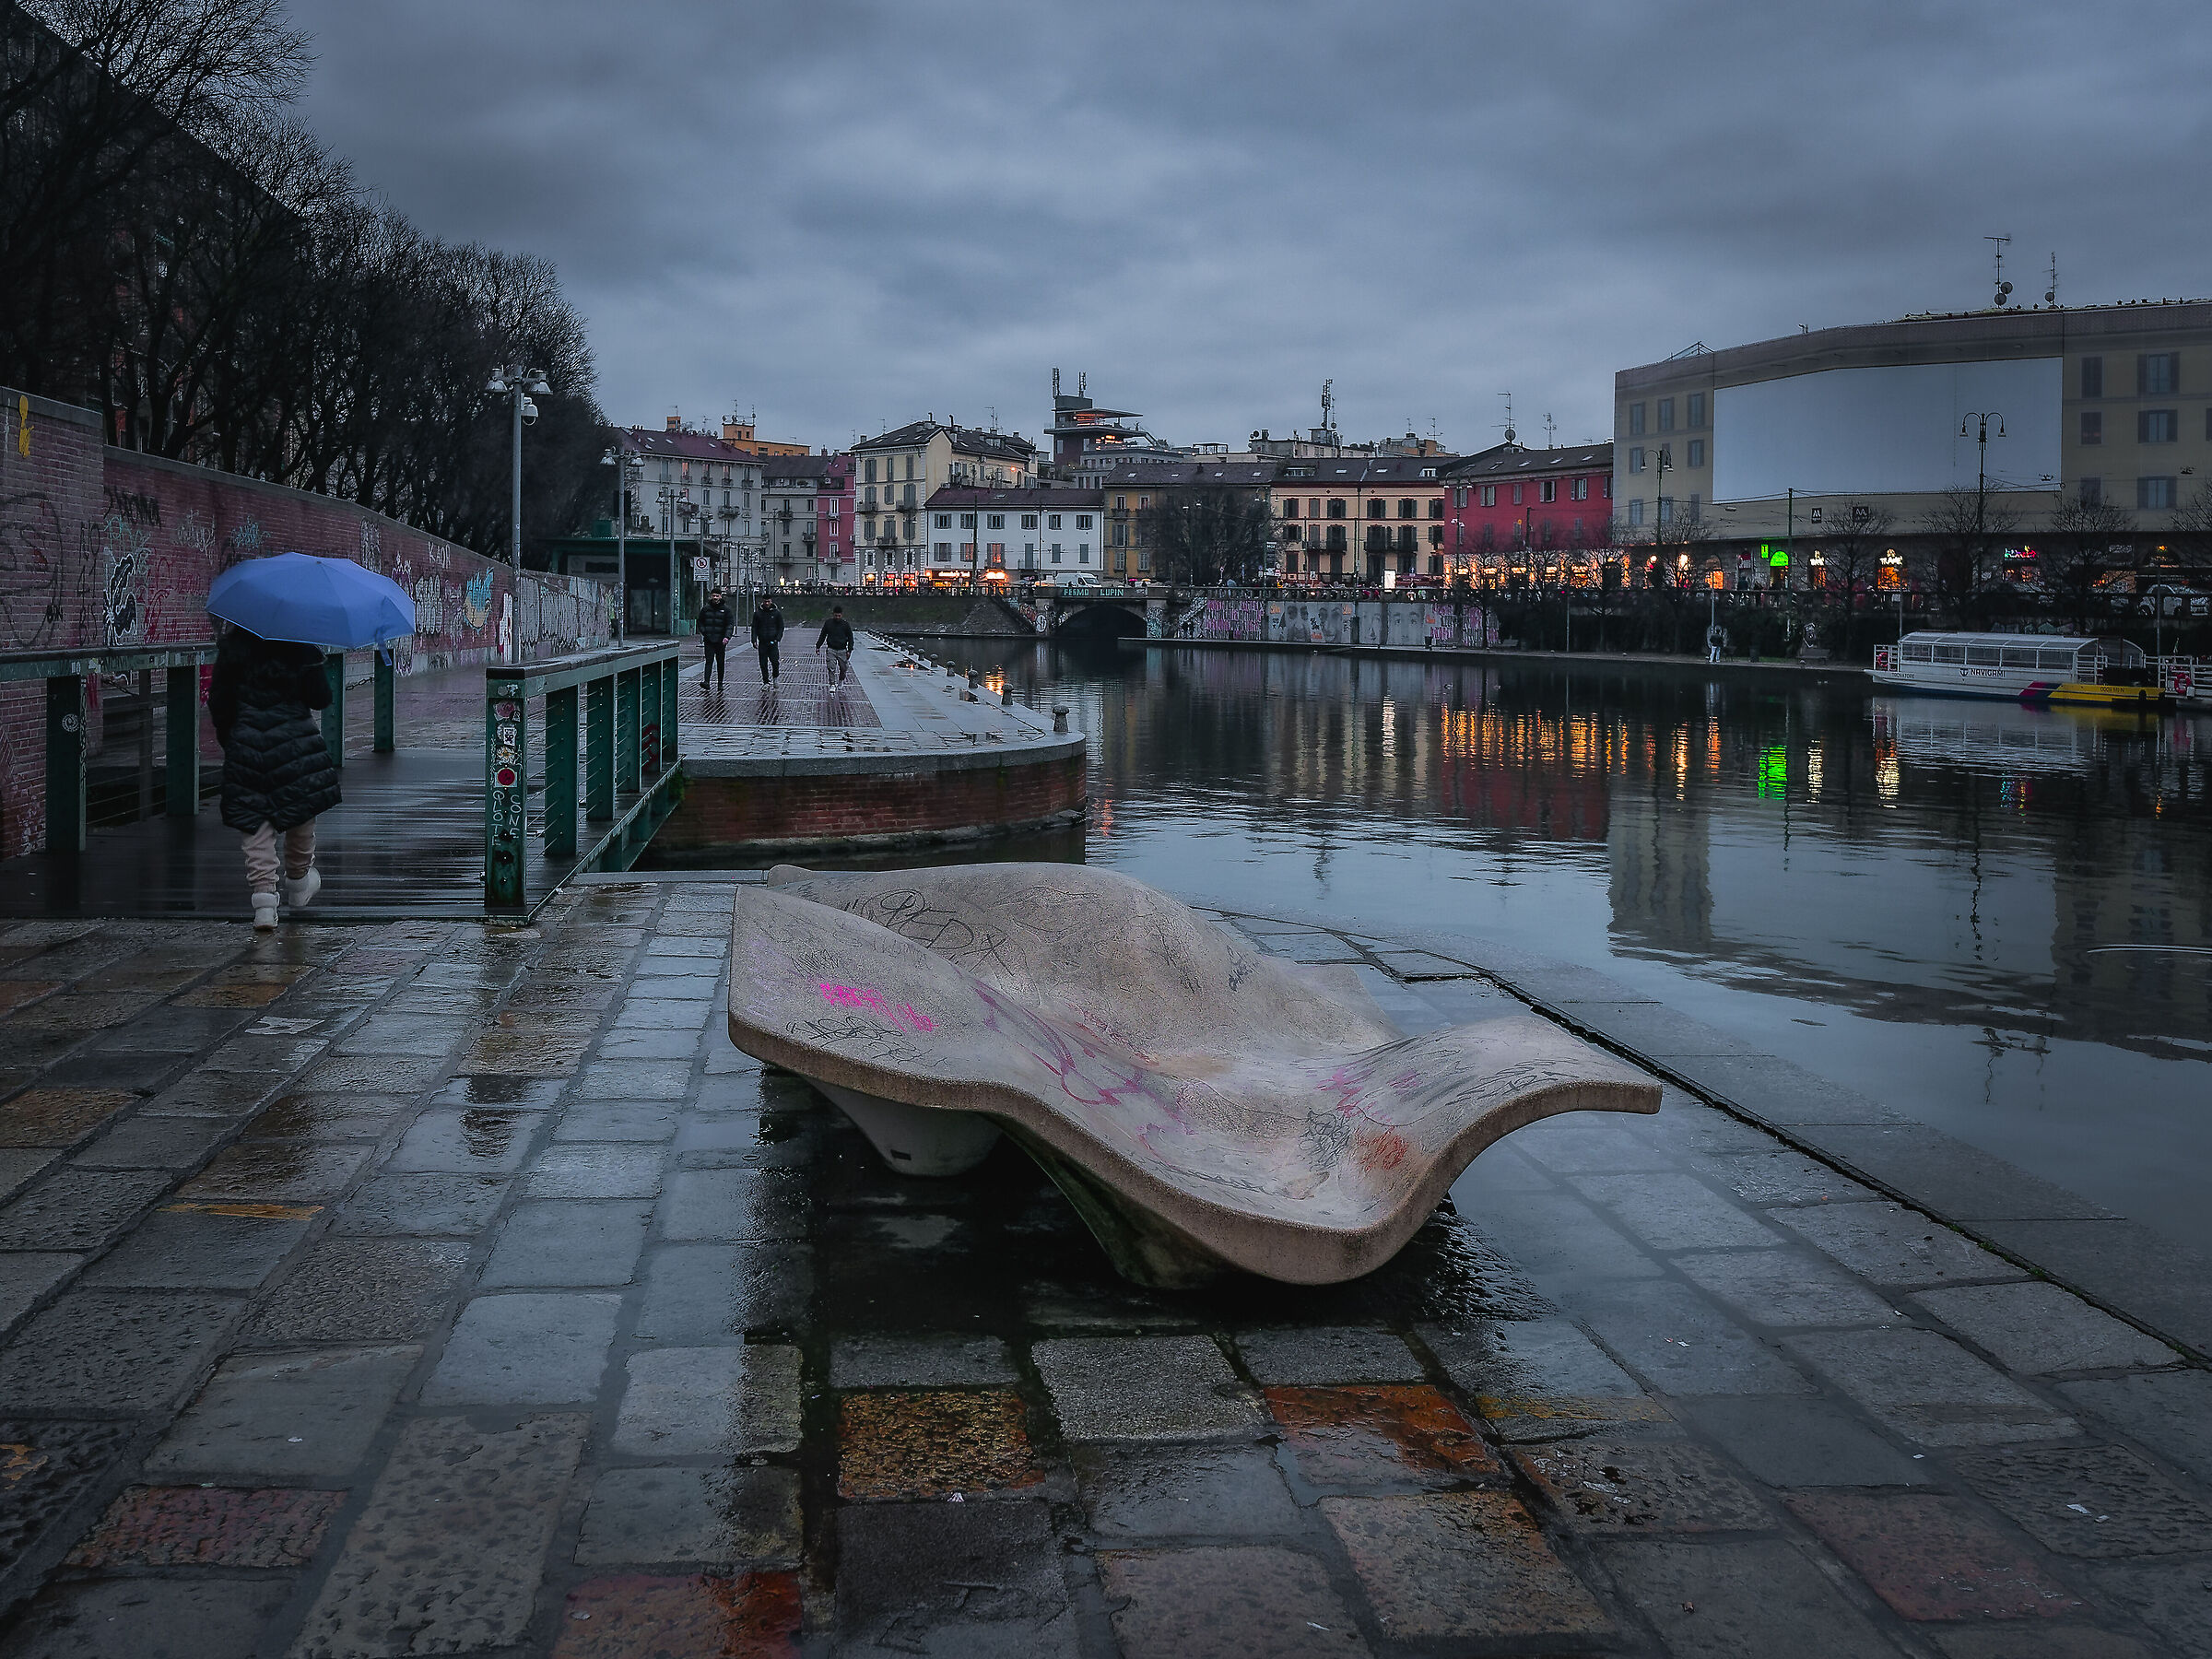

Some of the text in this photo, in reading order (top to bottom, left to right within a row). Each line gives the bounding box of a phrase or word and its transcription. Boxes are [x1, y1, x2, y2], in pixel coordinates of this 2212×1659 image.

[1100, 588, 1124, 596] LUPIN
[1971, 667, 2006, 677] NAVIGAMI
[509, 794, 523, 839] CONE
